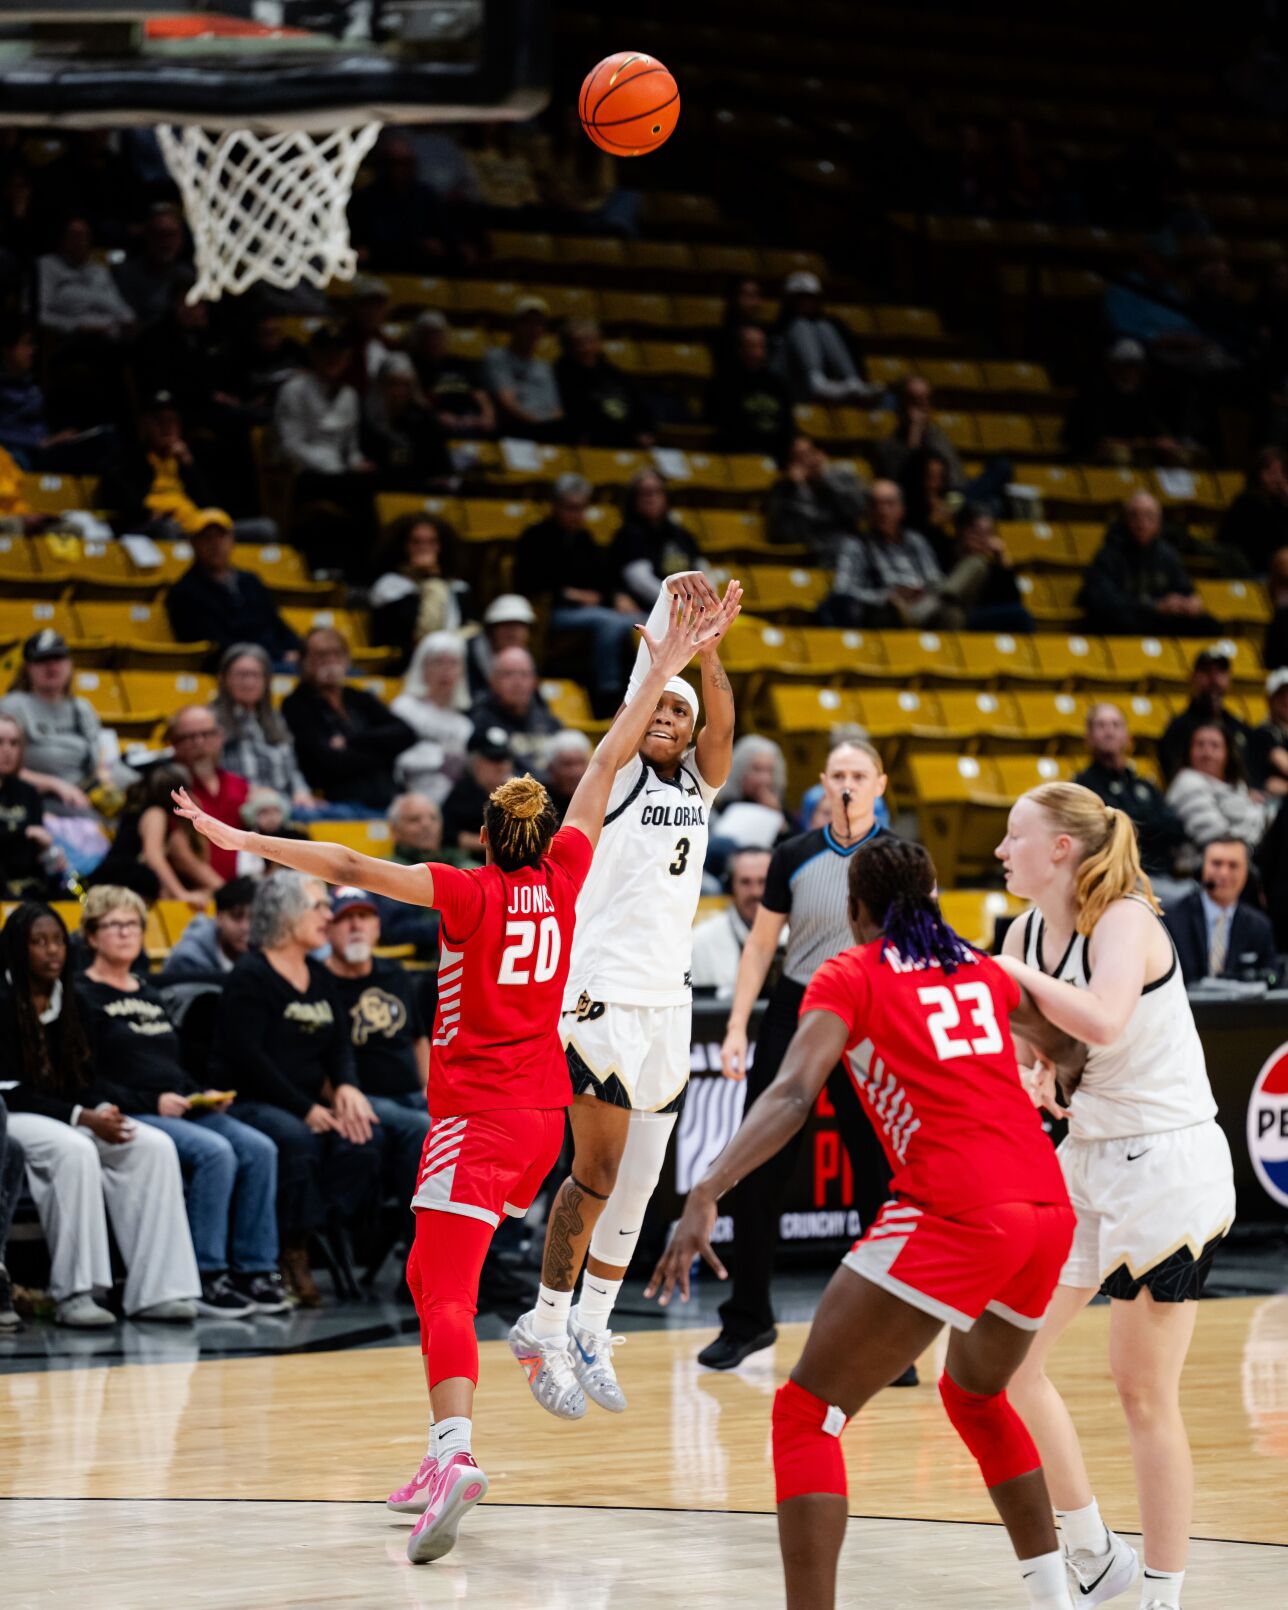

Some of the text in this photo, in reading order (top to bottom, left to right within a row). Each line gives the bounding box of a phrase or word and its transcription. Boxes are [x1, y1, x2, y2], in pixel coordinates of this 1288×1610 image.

[668, 837, 691, 876] 3
[497, 915, 561, 985] 20
[917, 981, 1004, 1061] 23
